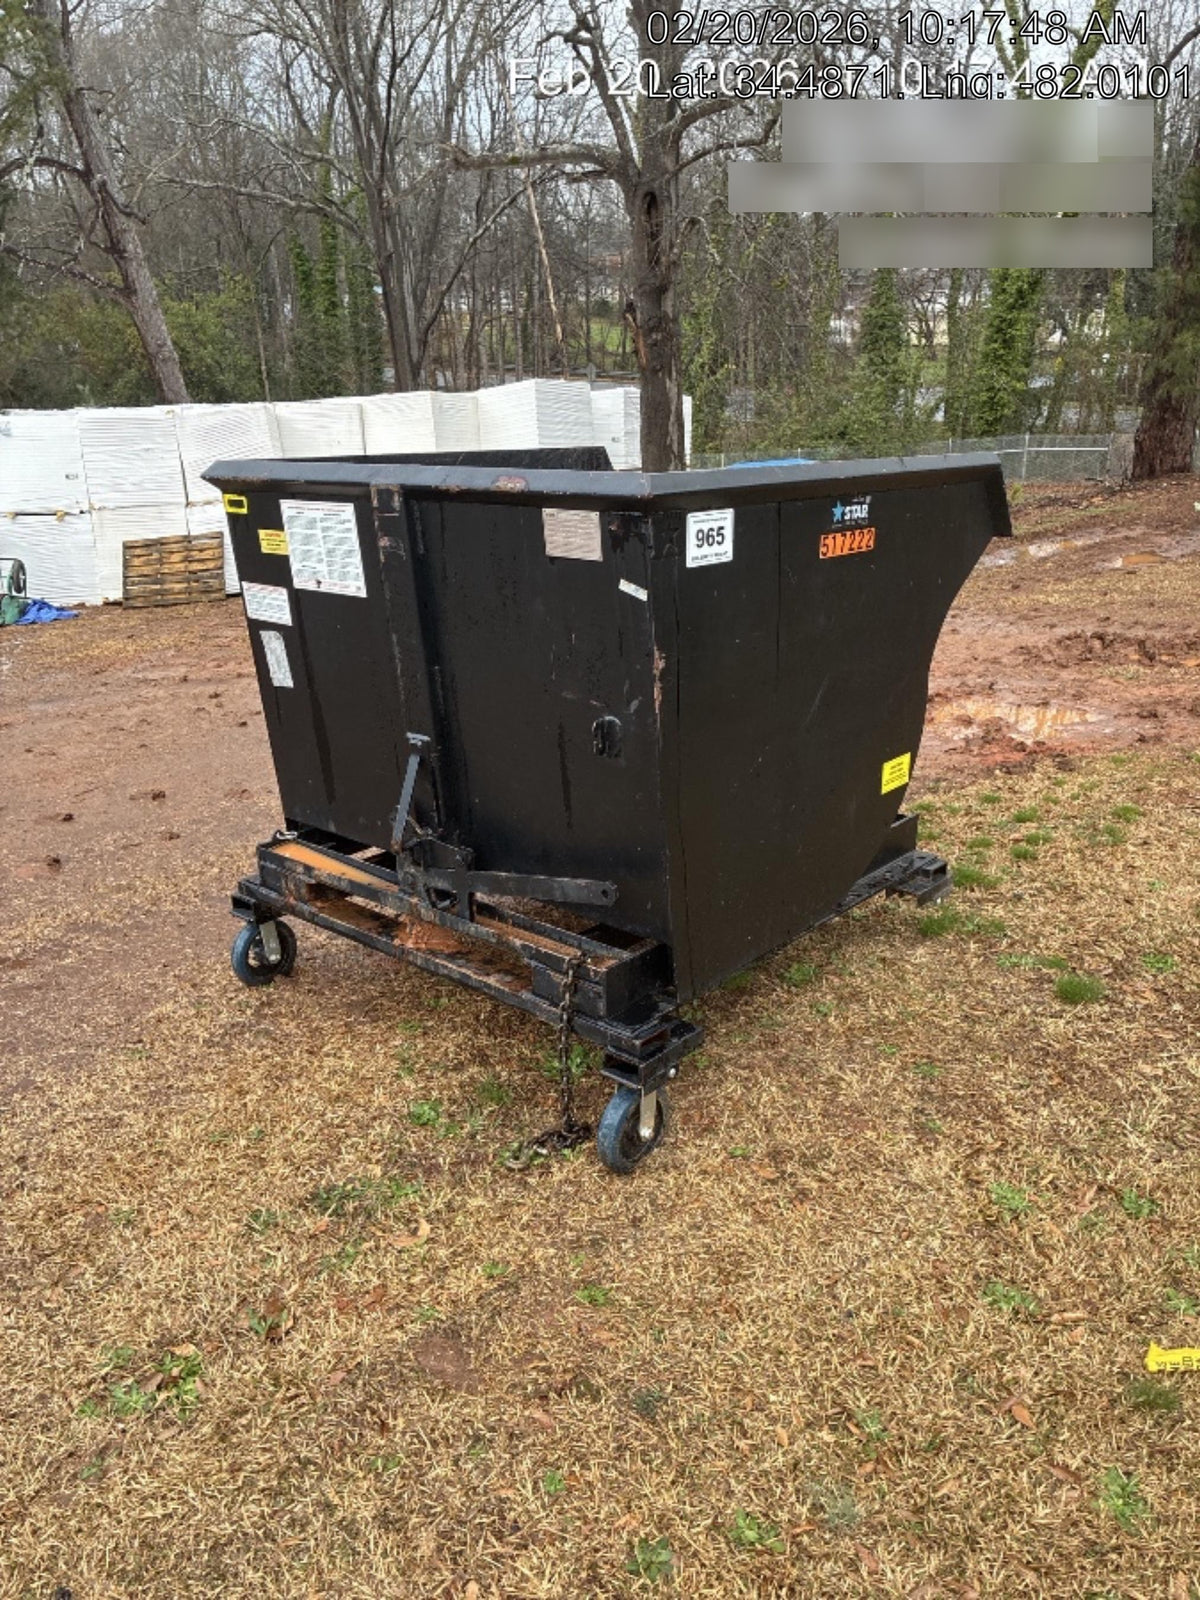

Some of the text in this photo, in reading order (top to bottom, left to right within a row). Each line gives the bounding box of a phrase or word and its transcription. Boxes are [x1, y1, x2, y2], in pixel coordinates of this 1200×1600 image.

[844, 504, 869, 520] STAR
[695, 526, 725, 548] 965
[821, 529, 874, 557] 517222
